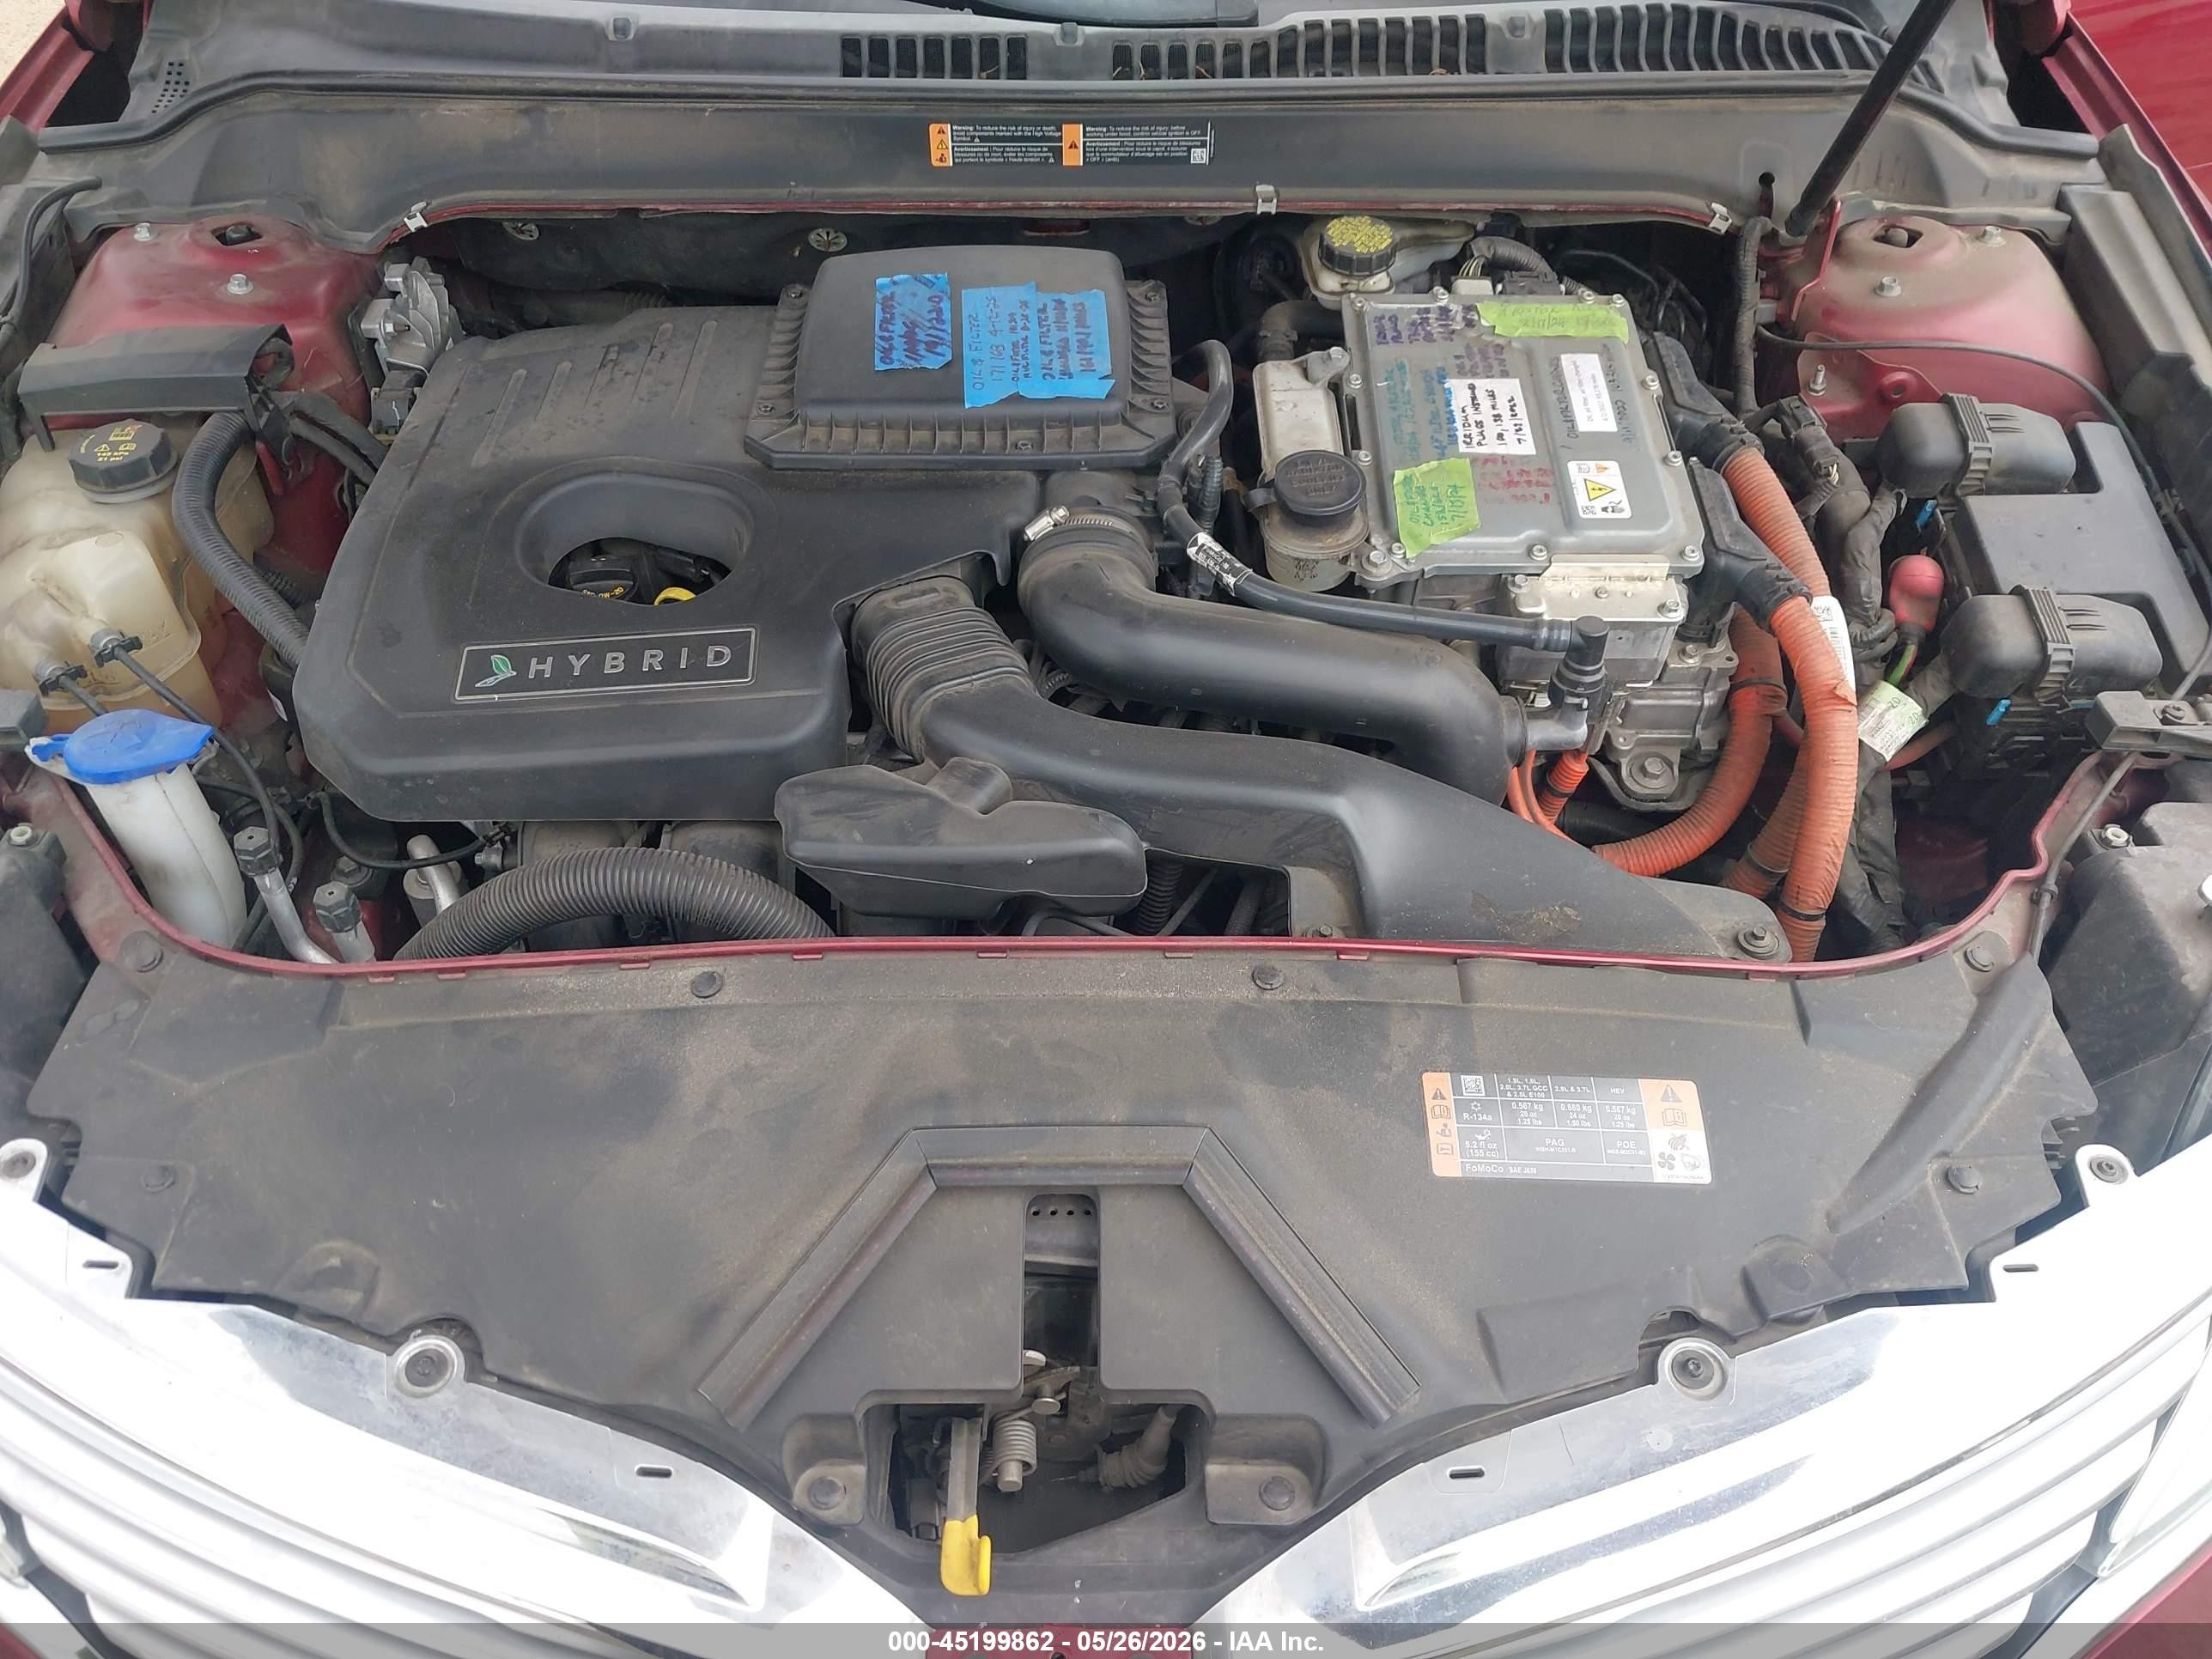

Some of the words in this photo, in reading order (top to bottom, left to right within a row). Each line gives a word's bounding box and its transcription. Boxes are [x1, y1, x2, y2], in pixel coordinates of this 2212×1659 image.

[969, 313, 983, 351] FILTER
[970, 369, 984, 390] OIL
[527, 645, 732, 678] HYBRID
[1534, 1102, 1543, 1111] kg
[1583, 1103, 1592, 1113] kg
[1626, 1106, 1636, 1115] kg
[1466, 1148, 1484, 1158] (155
[1486, 1148, 1498, 1158] cc)
[1465, 1164, 1504, 1173] FoMoCo
